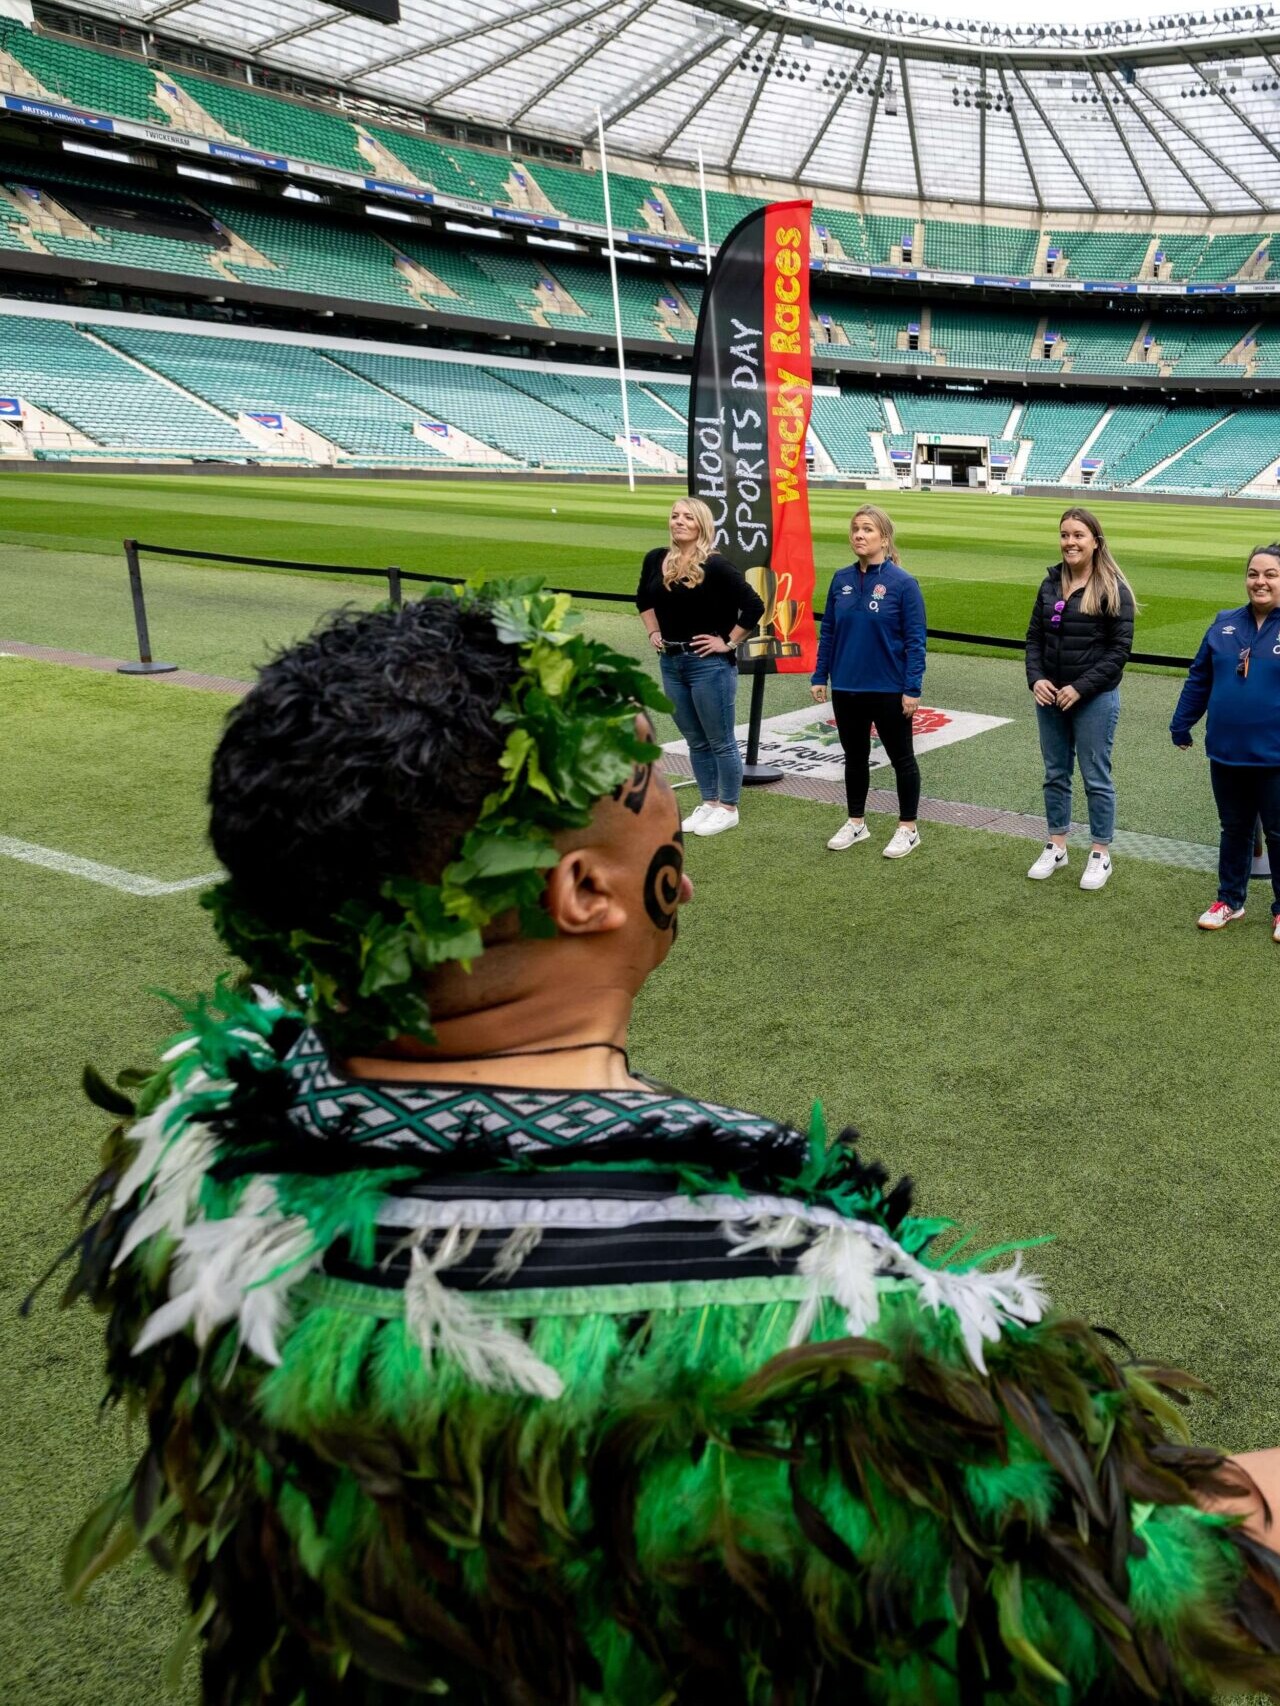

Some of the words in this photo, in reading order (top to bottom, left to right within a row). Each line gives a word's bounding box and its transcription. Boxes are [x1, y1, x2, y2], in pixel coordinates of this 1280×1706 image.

[22, 105, 53, 117] BRITISH
[54, 112, 86, 125] AIRWAYS
[144, 130, 190, 146] TWICKENHAM
[770, 227, 801, 354] Races
[730, 318, 762, 390] DAY
[695, 406, 729, 550] SCHOOL
[732, 408, 767, 552] SPORTS
[772, 368, 811, 504] Wacky
[764, 759, 823, 772] 1915
